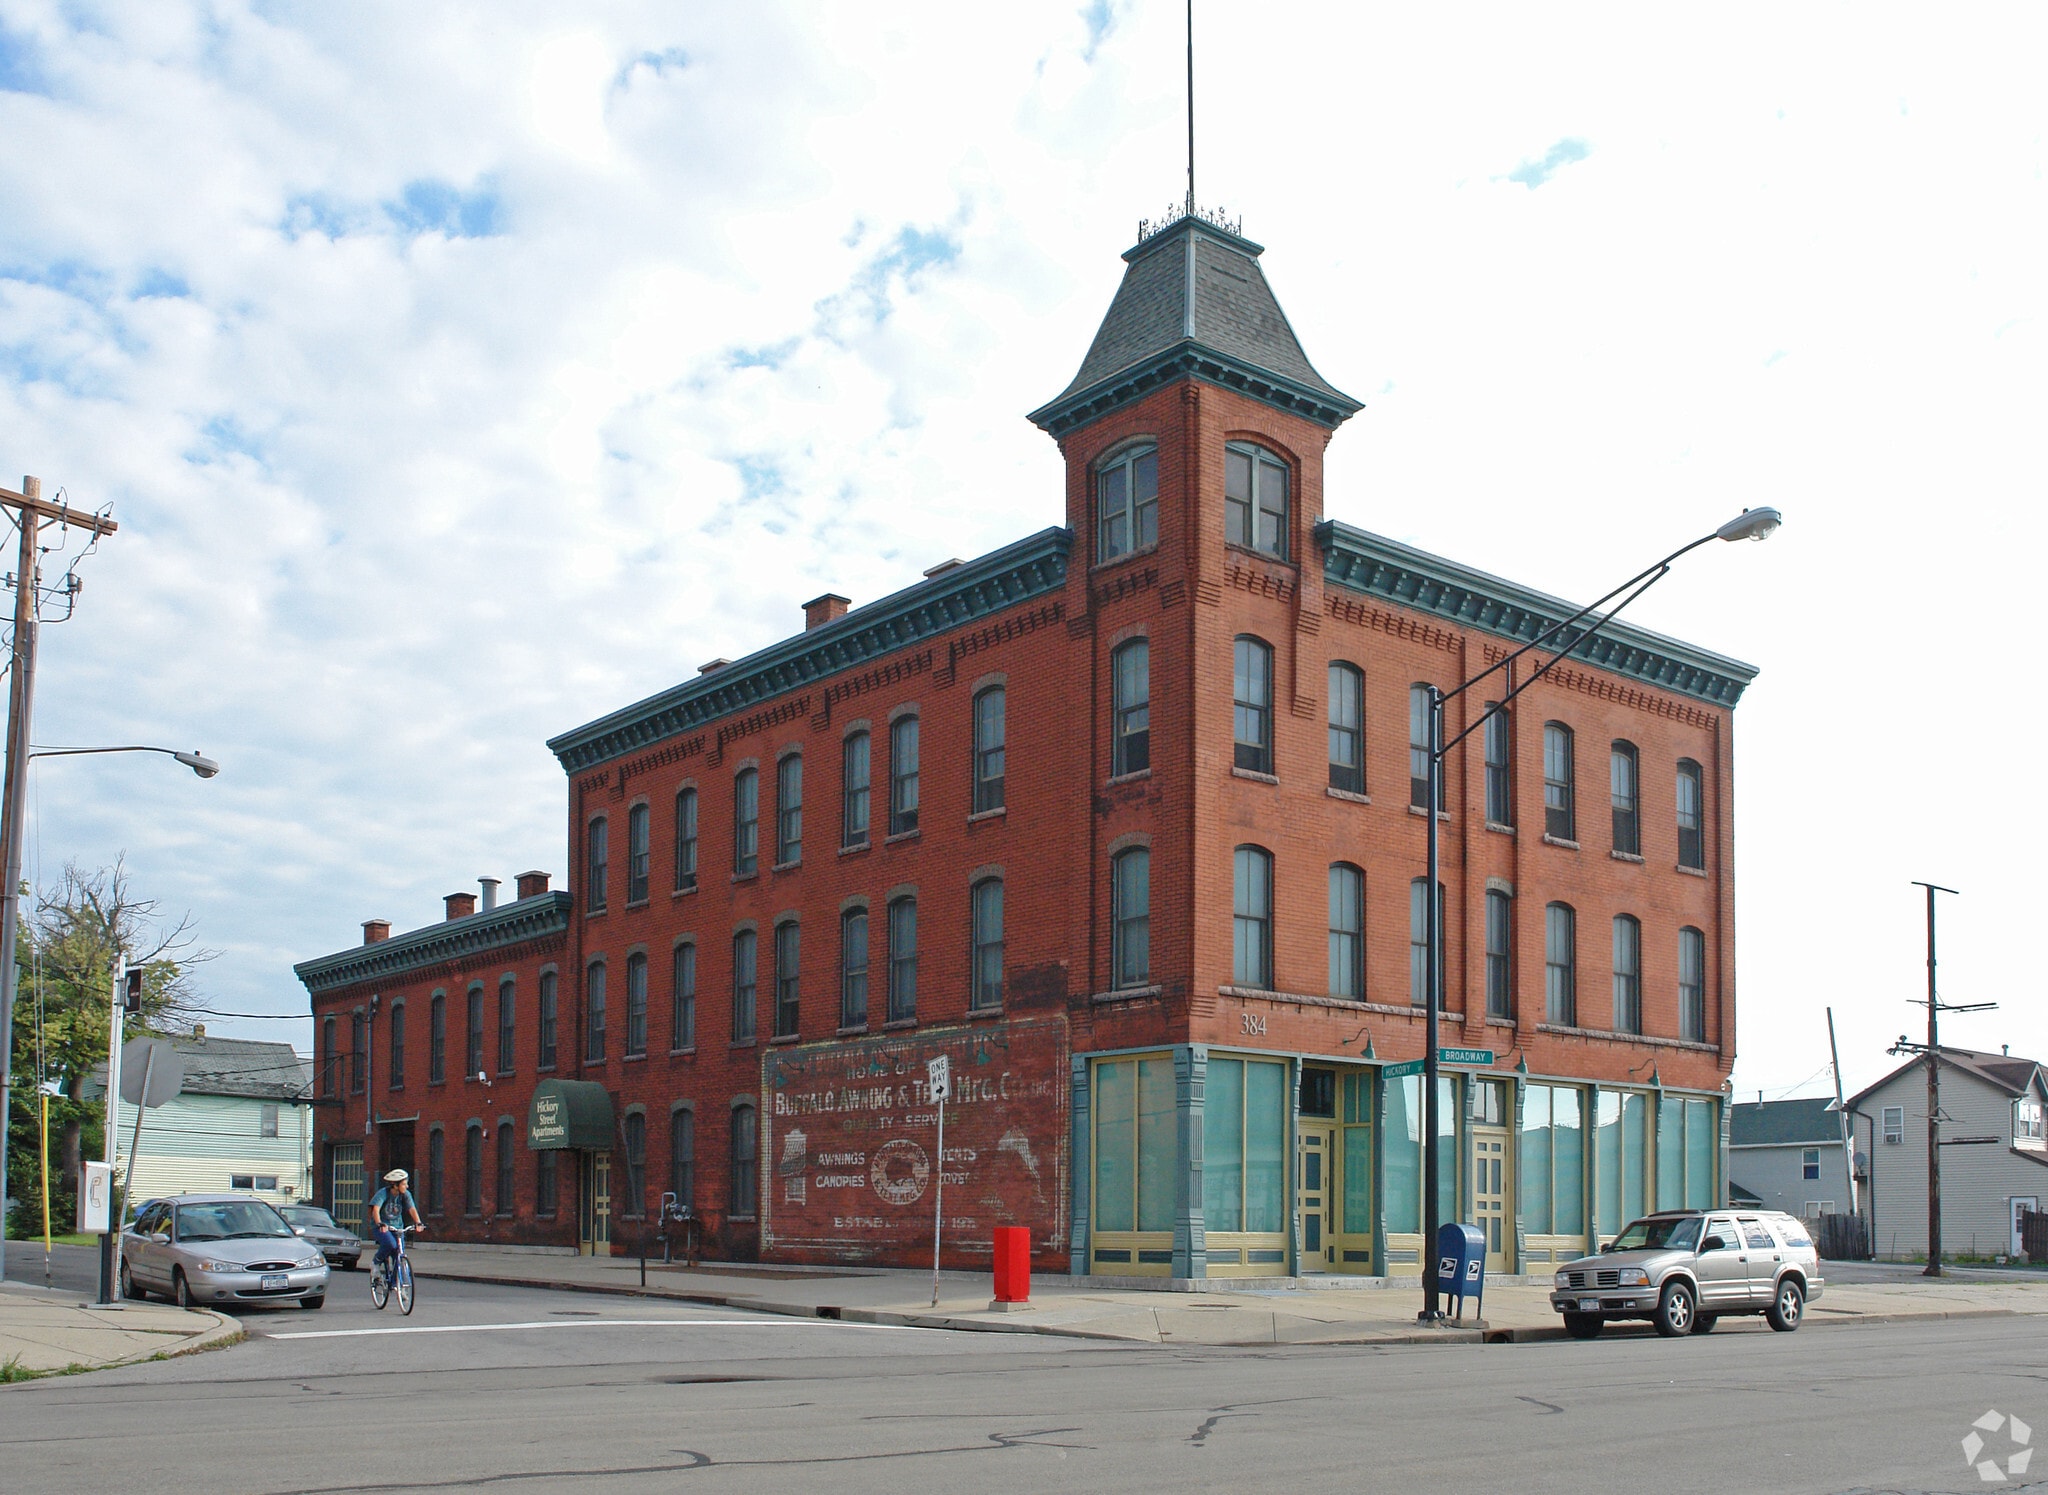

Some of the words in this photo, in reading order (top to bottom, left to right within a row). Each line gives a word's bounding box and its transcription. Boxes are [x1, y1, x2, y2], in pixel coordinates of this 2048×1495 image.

[1240, 1013, 1267, 1036] 384
[1445, 1050, 1486, 1062] BROADWAY
[931, 1060, 945, 1074] ONE
[1385, 1064, 1411, 1077] HICKORY
[932, 1071, 946, 1085] WAY
[837, 1086, 893, 1112] AWNING
[537, 1100, 559, 1114] Hickory
[540, 1114, 556, 1125] Street
[532, 1125, 564, 1140] Apartments
[818, 1152, 865, 1166] AWNINGS
[815, 1175, 865, 1188] CANOPIES
